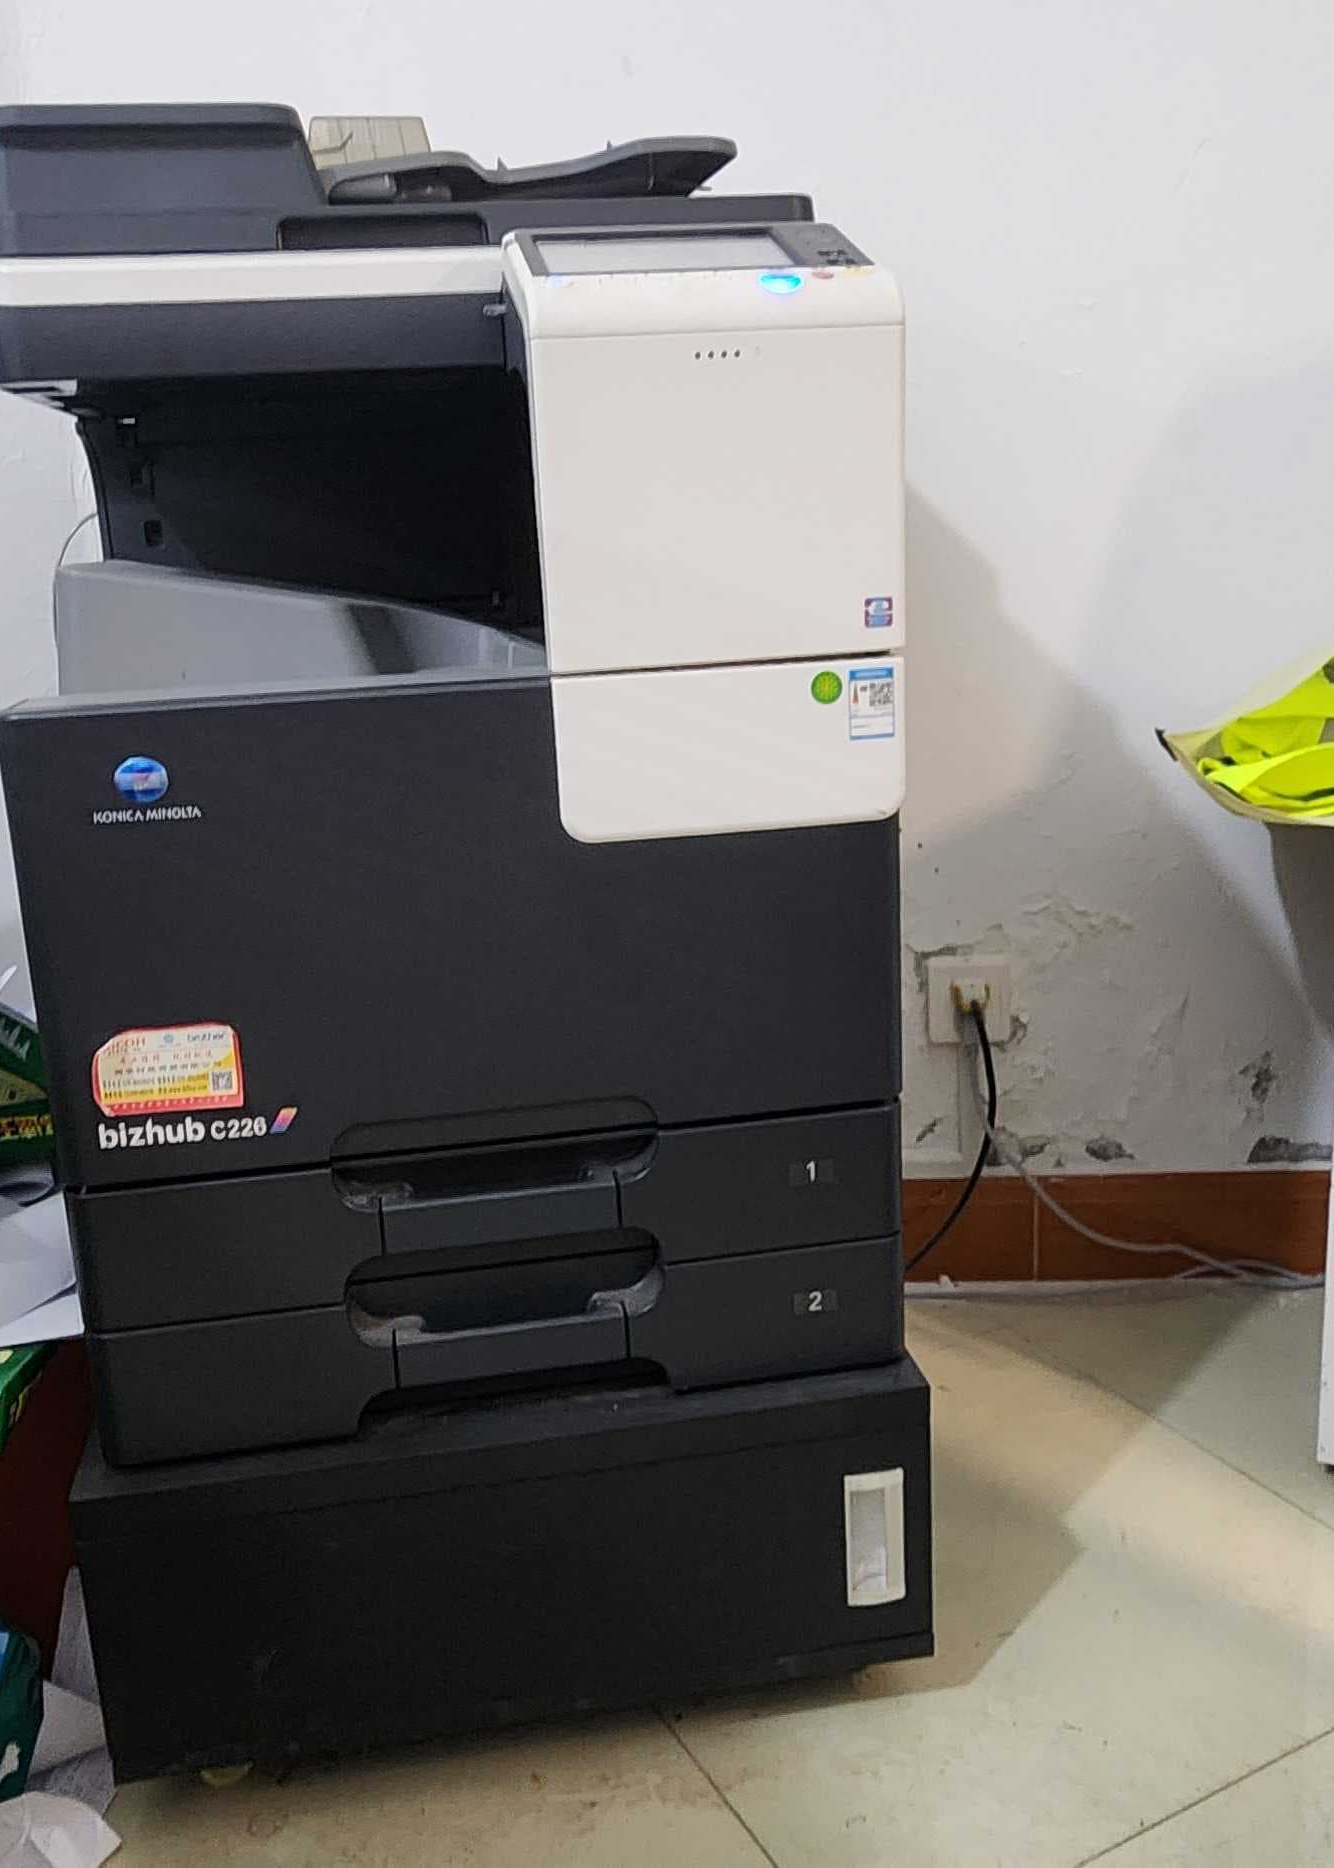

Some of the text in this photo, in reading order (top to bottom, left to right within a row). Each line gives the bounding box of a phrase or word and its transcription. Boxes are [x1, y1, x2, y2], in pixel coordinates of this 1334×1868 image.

[93, 805, 202, 824] KONICA MINOLTA
[98, 1116, 268, 1150] bizhub C226
[805, 1160, 817, 1182] 1
[808, 1291, 822, 1312] 2
